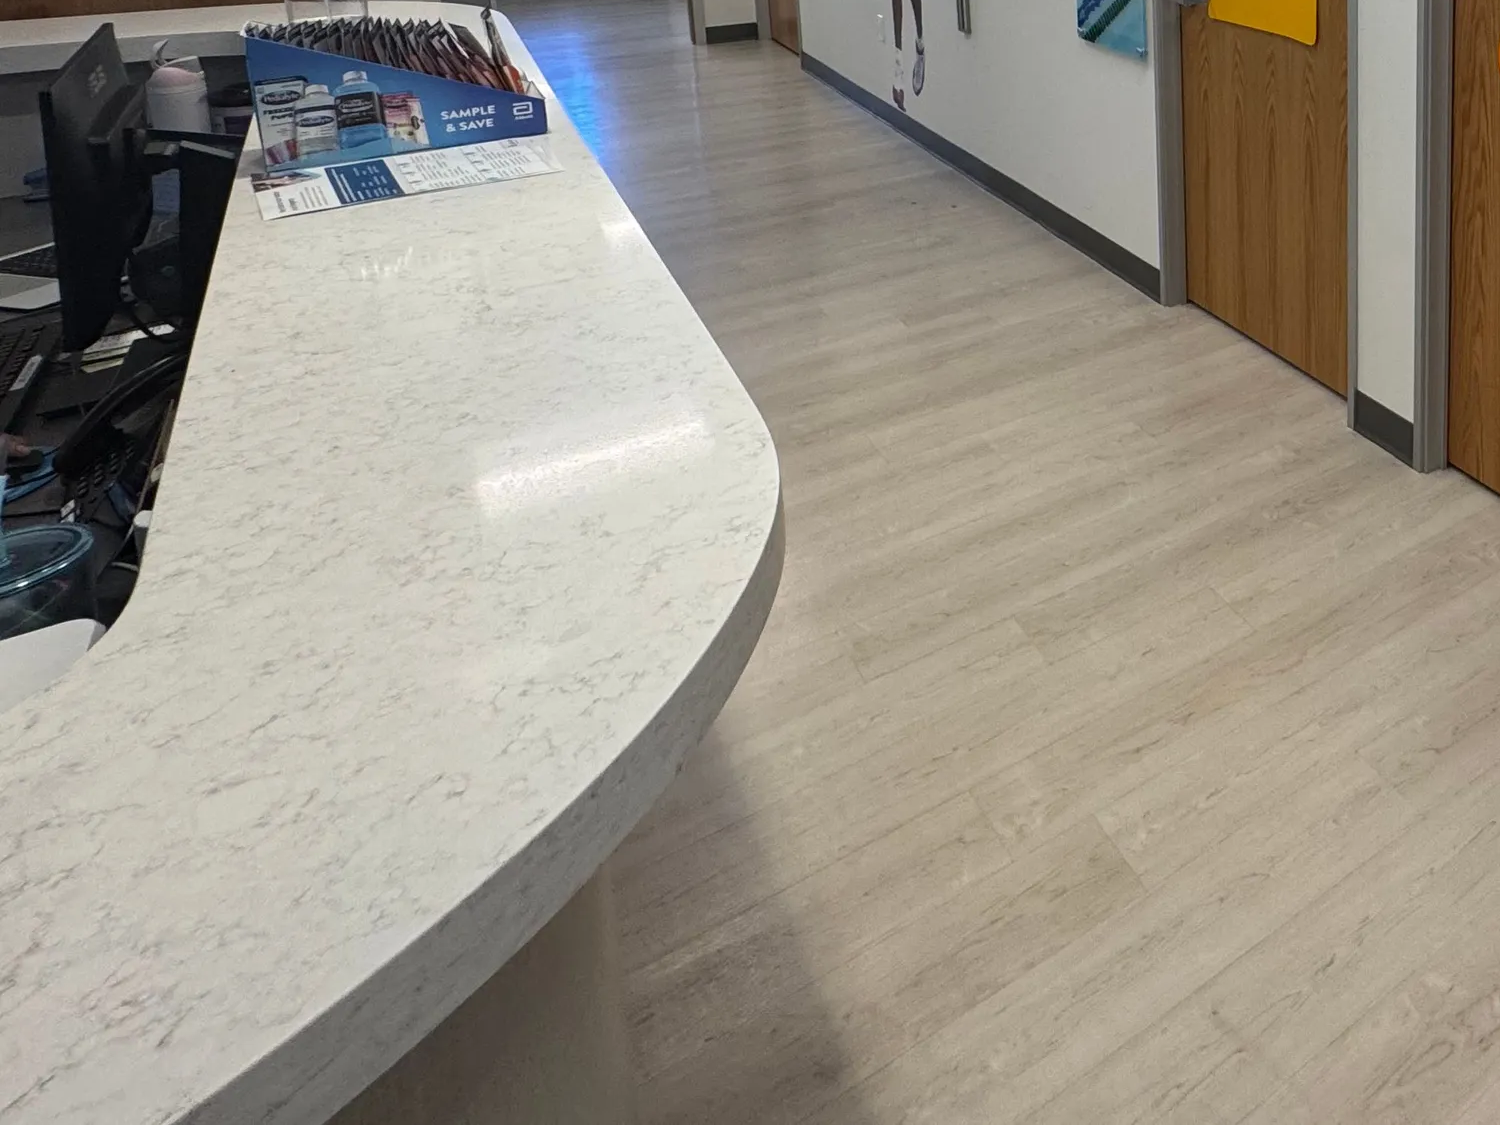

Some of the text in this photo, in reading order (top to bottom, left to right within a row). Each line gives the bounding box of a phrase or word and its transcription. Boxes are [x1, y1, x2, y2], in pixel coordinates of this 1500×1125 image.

[440, 105, 496, 120] SAMPLE
[446, 118, 494, 132] & SAVE
